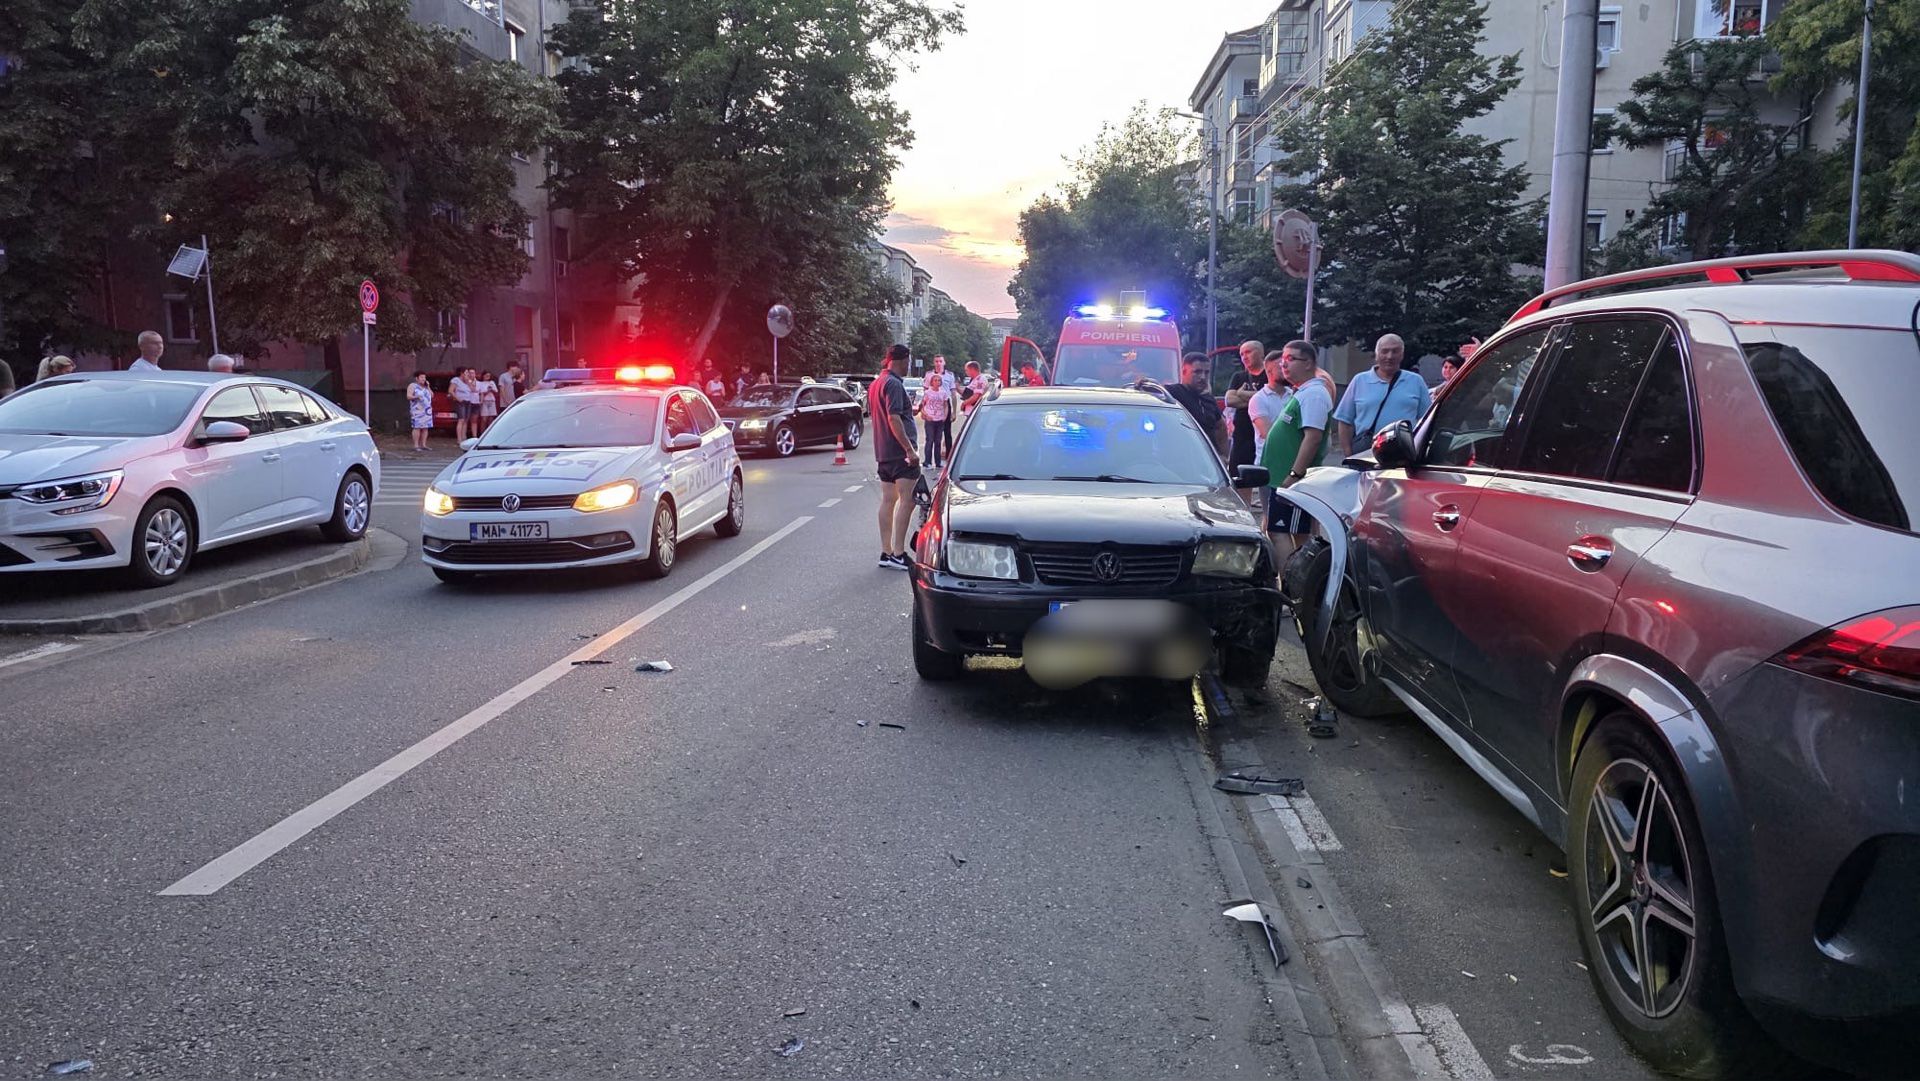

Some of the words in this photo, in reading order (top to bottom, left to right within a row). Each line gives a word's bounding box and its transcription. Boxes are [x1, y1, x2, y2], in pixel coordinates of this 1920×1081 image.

[1080, 331, 1161, 343] POMPIERII
[482, 525, 501, 538] MAI
[510, 524, 542, 537] 41173
